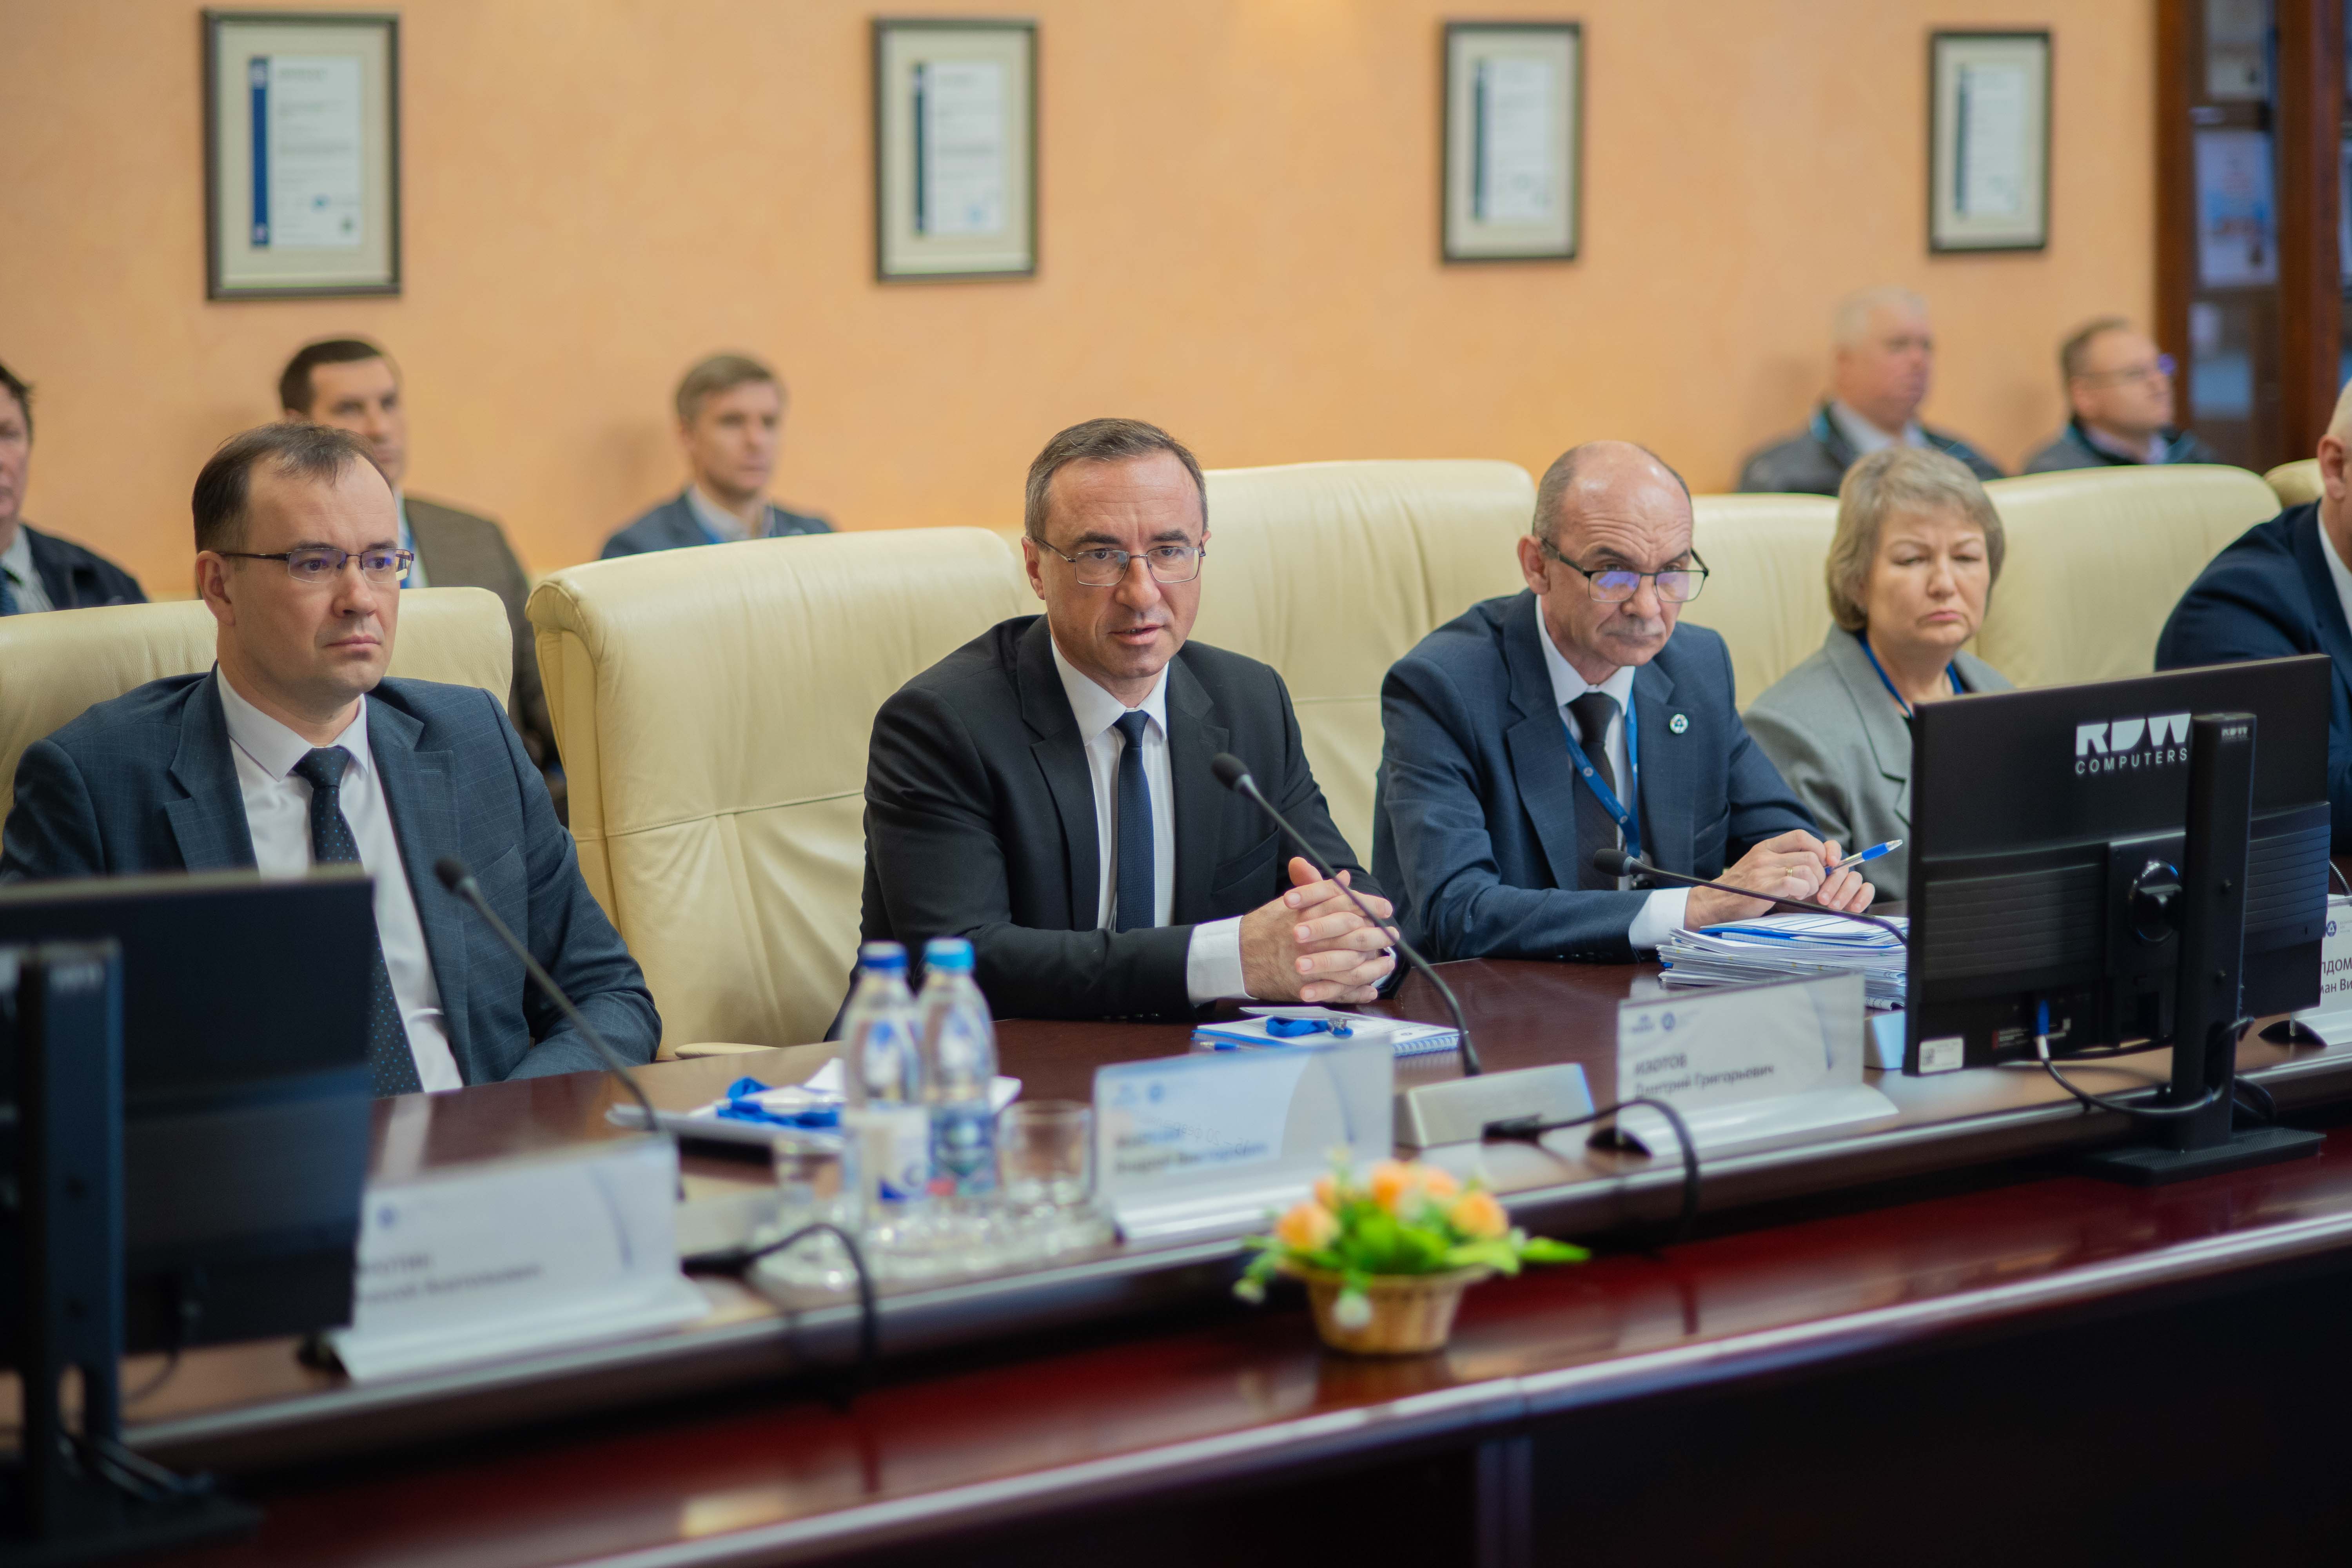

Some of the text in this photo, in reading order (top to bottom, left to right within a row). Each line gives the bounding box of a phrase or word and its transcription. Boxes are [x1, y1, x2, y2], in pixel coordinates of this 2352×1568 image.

[2076, 713, 2192, 755] RDW
[2076, 748, 2188, 774] COMPUTERS
[1635, 1053, 1687, 1076] ИЗОТОВ
[1695, 1065, 1775, 1089] Григорьевич
